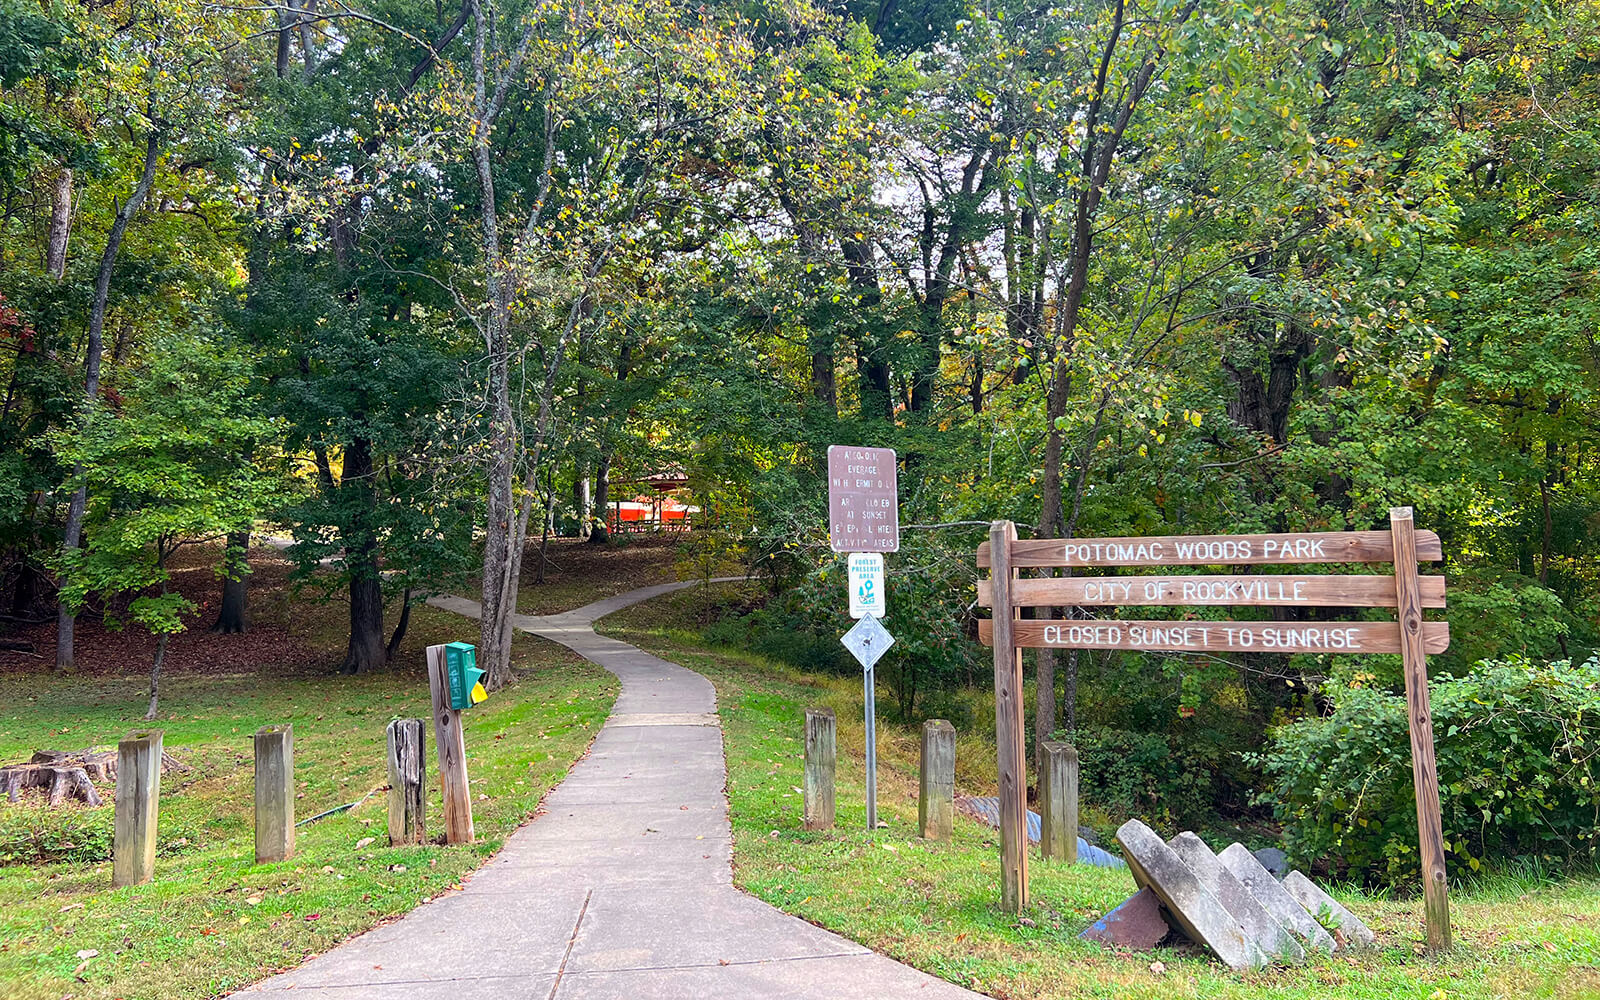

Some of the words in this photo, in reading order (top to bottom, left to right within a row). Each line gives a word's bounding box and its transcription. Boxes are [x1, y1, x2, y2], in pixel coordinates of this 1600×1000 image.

[832, 478, 849, 488] WIH
[862, 510, 887, 520] SUNSET
[1064, 542, 1164, 562] POTOMAC
[1175, 540, 1251, 560] WOODS
[1264, 538, 1326, 559] PARK
[1084, 581, 1132, 601] CITY
[1144, 581, 1170, 600] OF
[1182, 581, 1308, 602] ROCKVILLE
[1043, 625, 1122, 645] CLOSED
[1129, 626, 1211, 647] SUNSET
[1223, 627, 1254, 647] TO
[1262, 628, 1361, 649] SUNRISE
